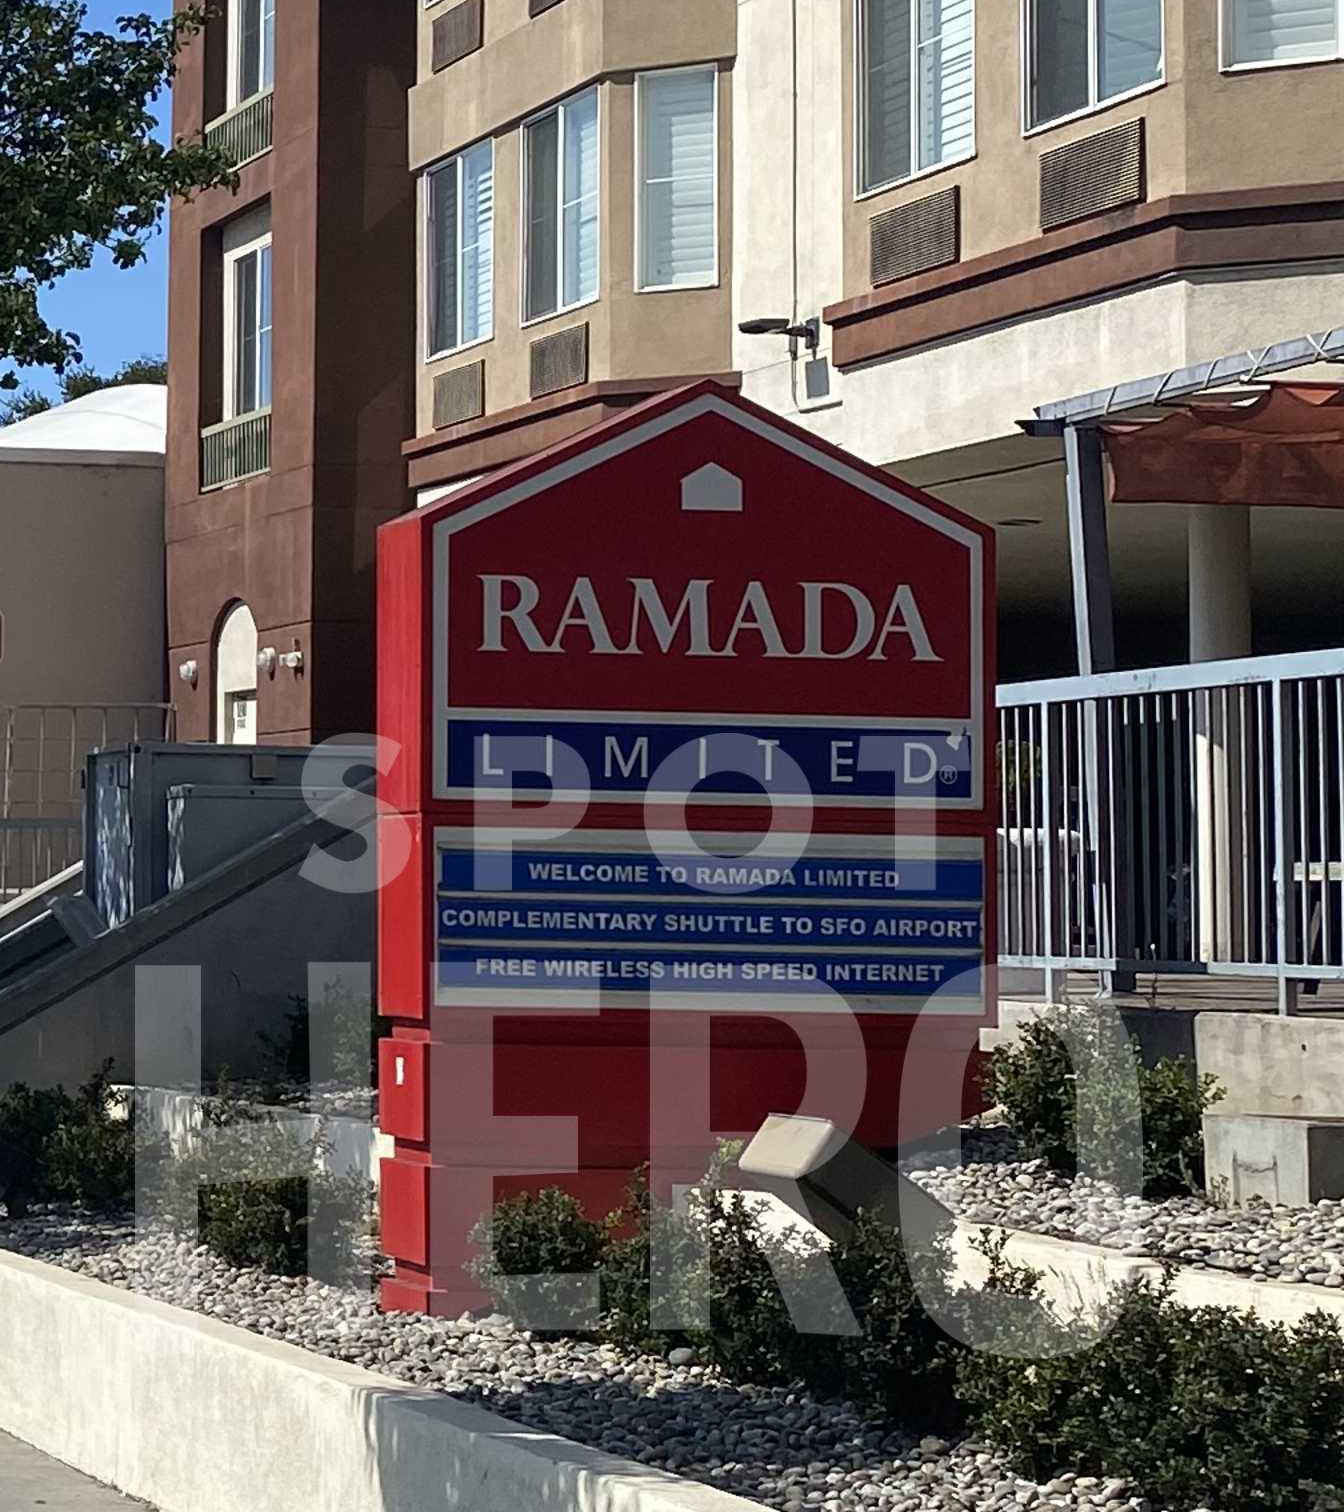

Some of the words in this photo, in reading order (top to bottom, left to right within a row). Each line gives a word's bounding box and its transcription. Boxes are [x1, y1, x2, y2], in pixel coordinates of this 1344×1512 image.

[476, 573, 943, 663] RAMADA
[528, 863, 649, 883] WELCOME
[656, 866, 687, 884] TO
[696, 867, 796, 886] RAMADA
[804, 869, 900, 888] LIMITED
[441, 909, 657, 931] COMPLEMENTARY
[664, 914, 774, 933] SHUTTLE
[781, 916, 812, 934] TO
[820, 918, 866, 936] SFO
[872, 919, 977, 938] AIRPORT
[475, 958, 536, 977] FREE
[544, 959, 665, 979] WIRELESS
[673, 961, 733, 980] HIGH
[741, 963, 817, 981] SPEED
[825, 964, 944, 982] INTERNET
